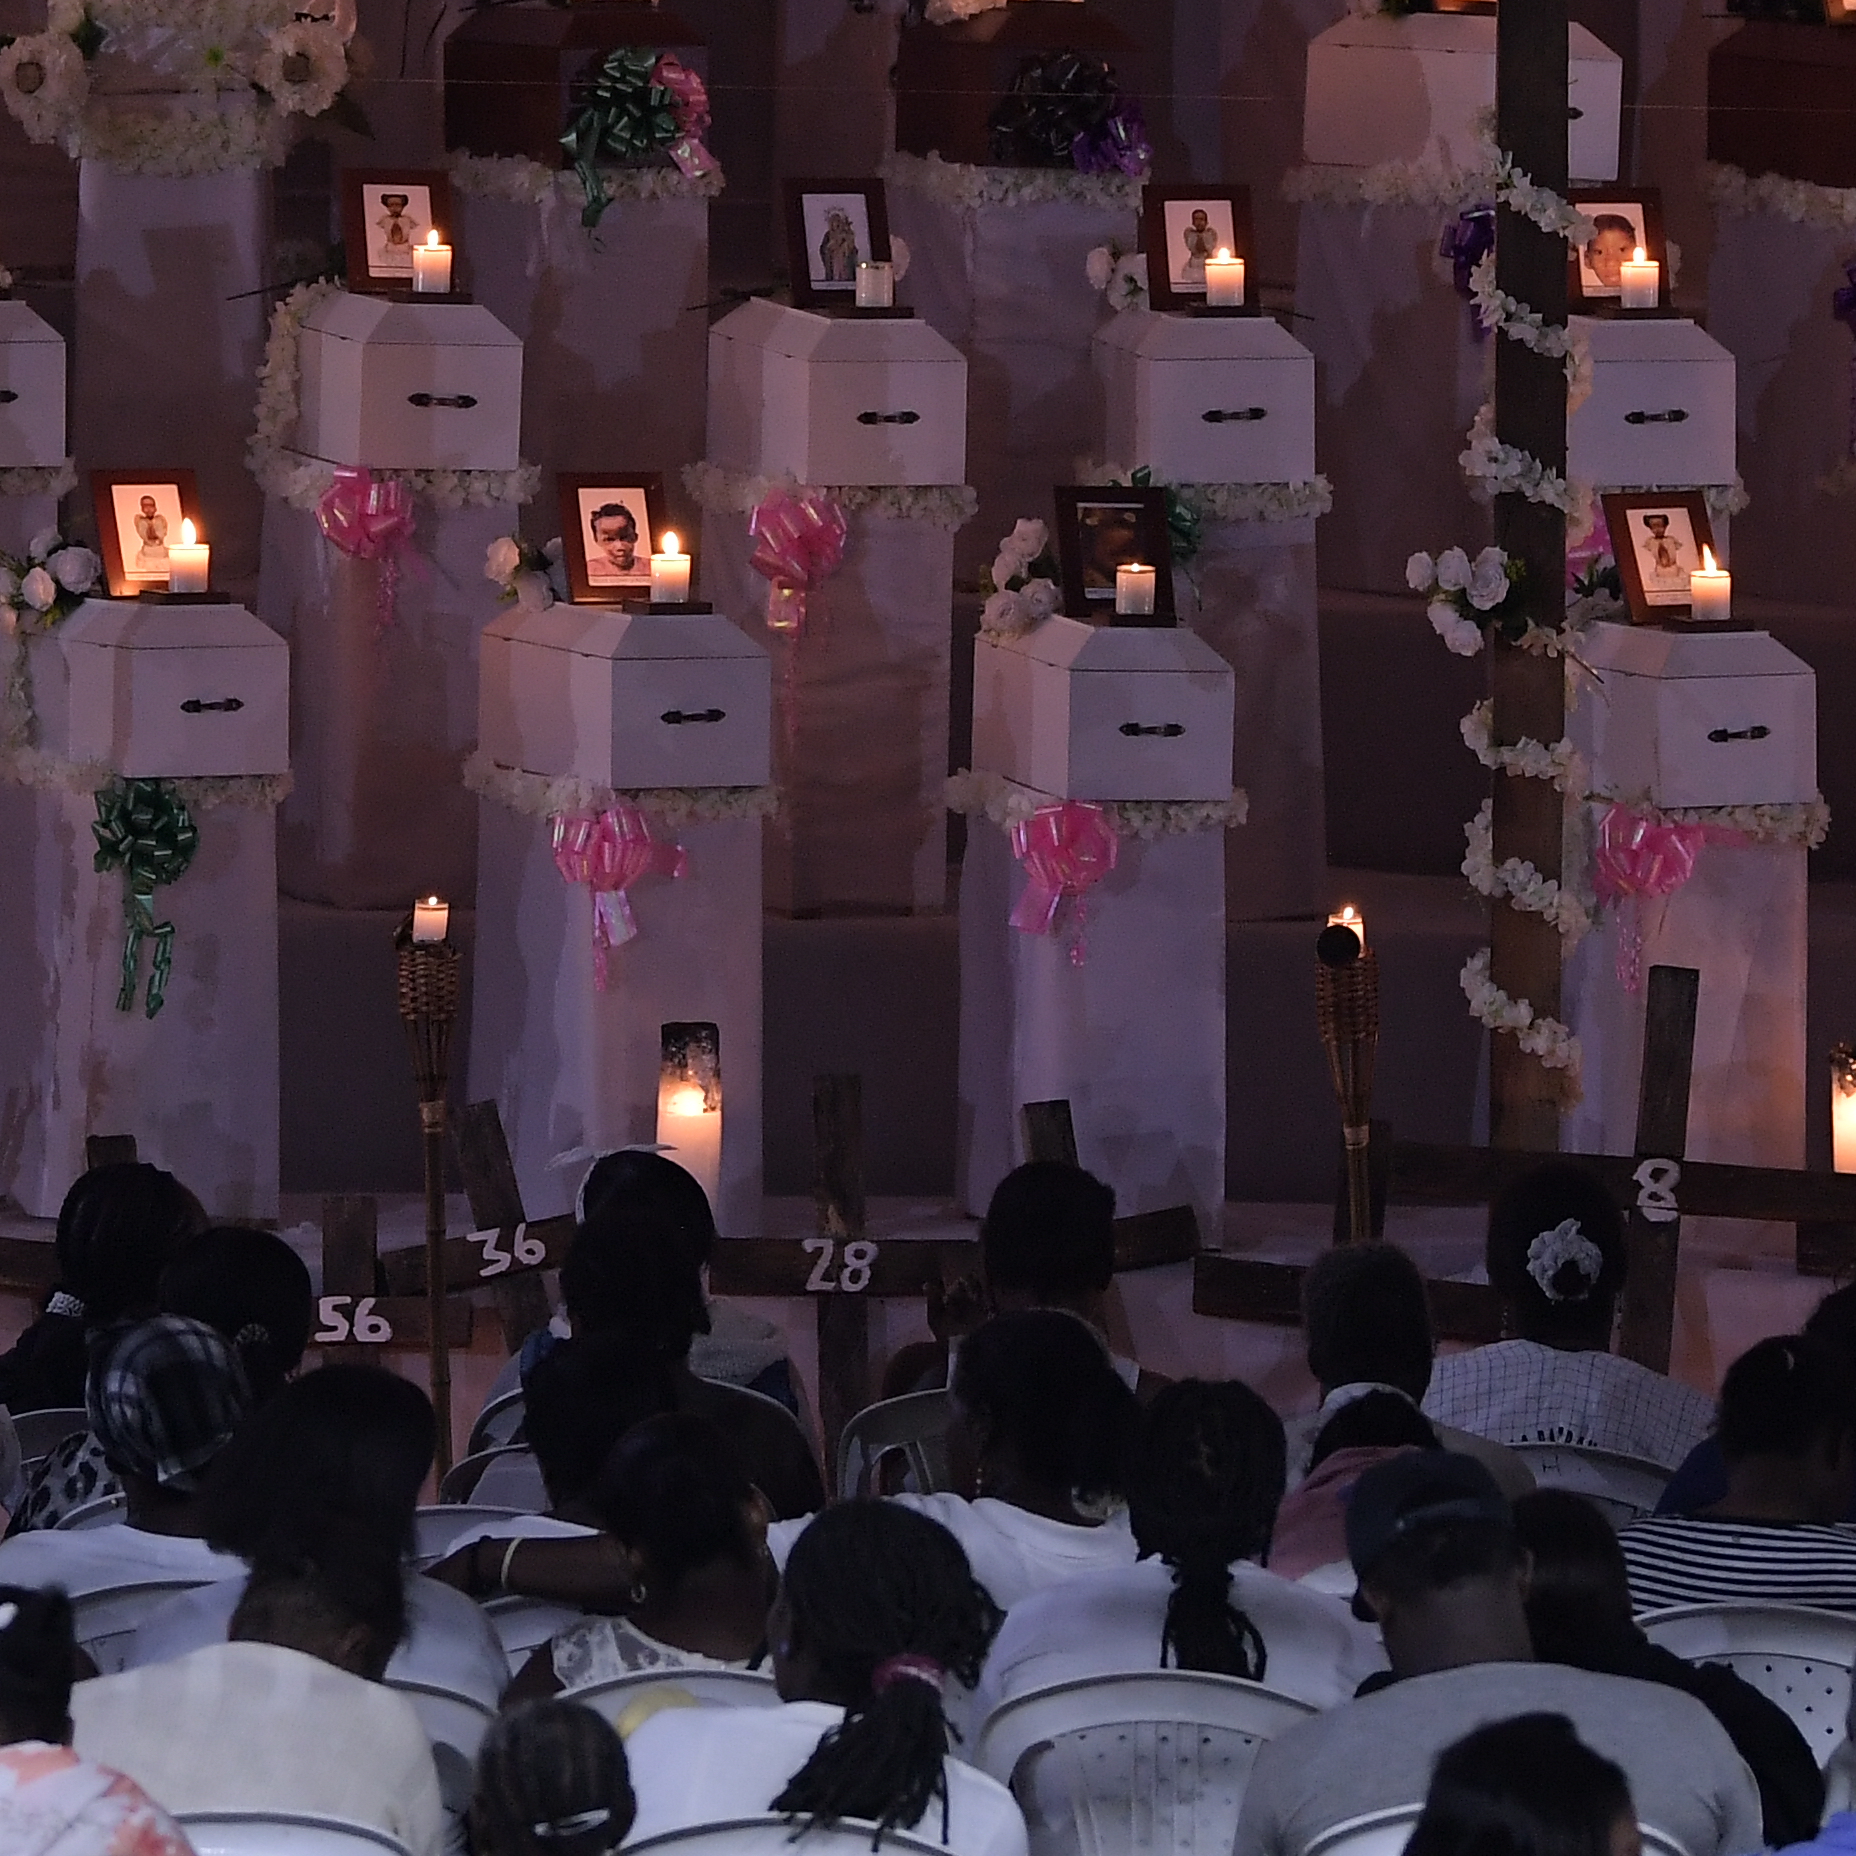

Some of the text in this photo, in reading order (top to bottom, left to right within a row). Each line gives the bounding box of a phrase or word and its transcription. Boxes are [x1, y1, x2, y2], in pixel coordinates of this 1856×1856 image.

[1632, 1158, 1680, 1222] 8
[466, 1222, 546, 1278] 36
[801, 1237, 879, 1292] 28
[314, 1295, 393, 1344] 56
